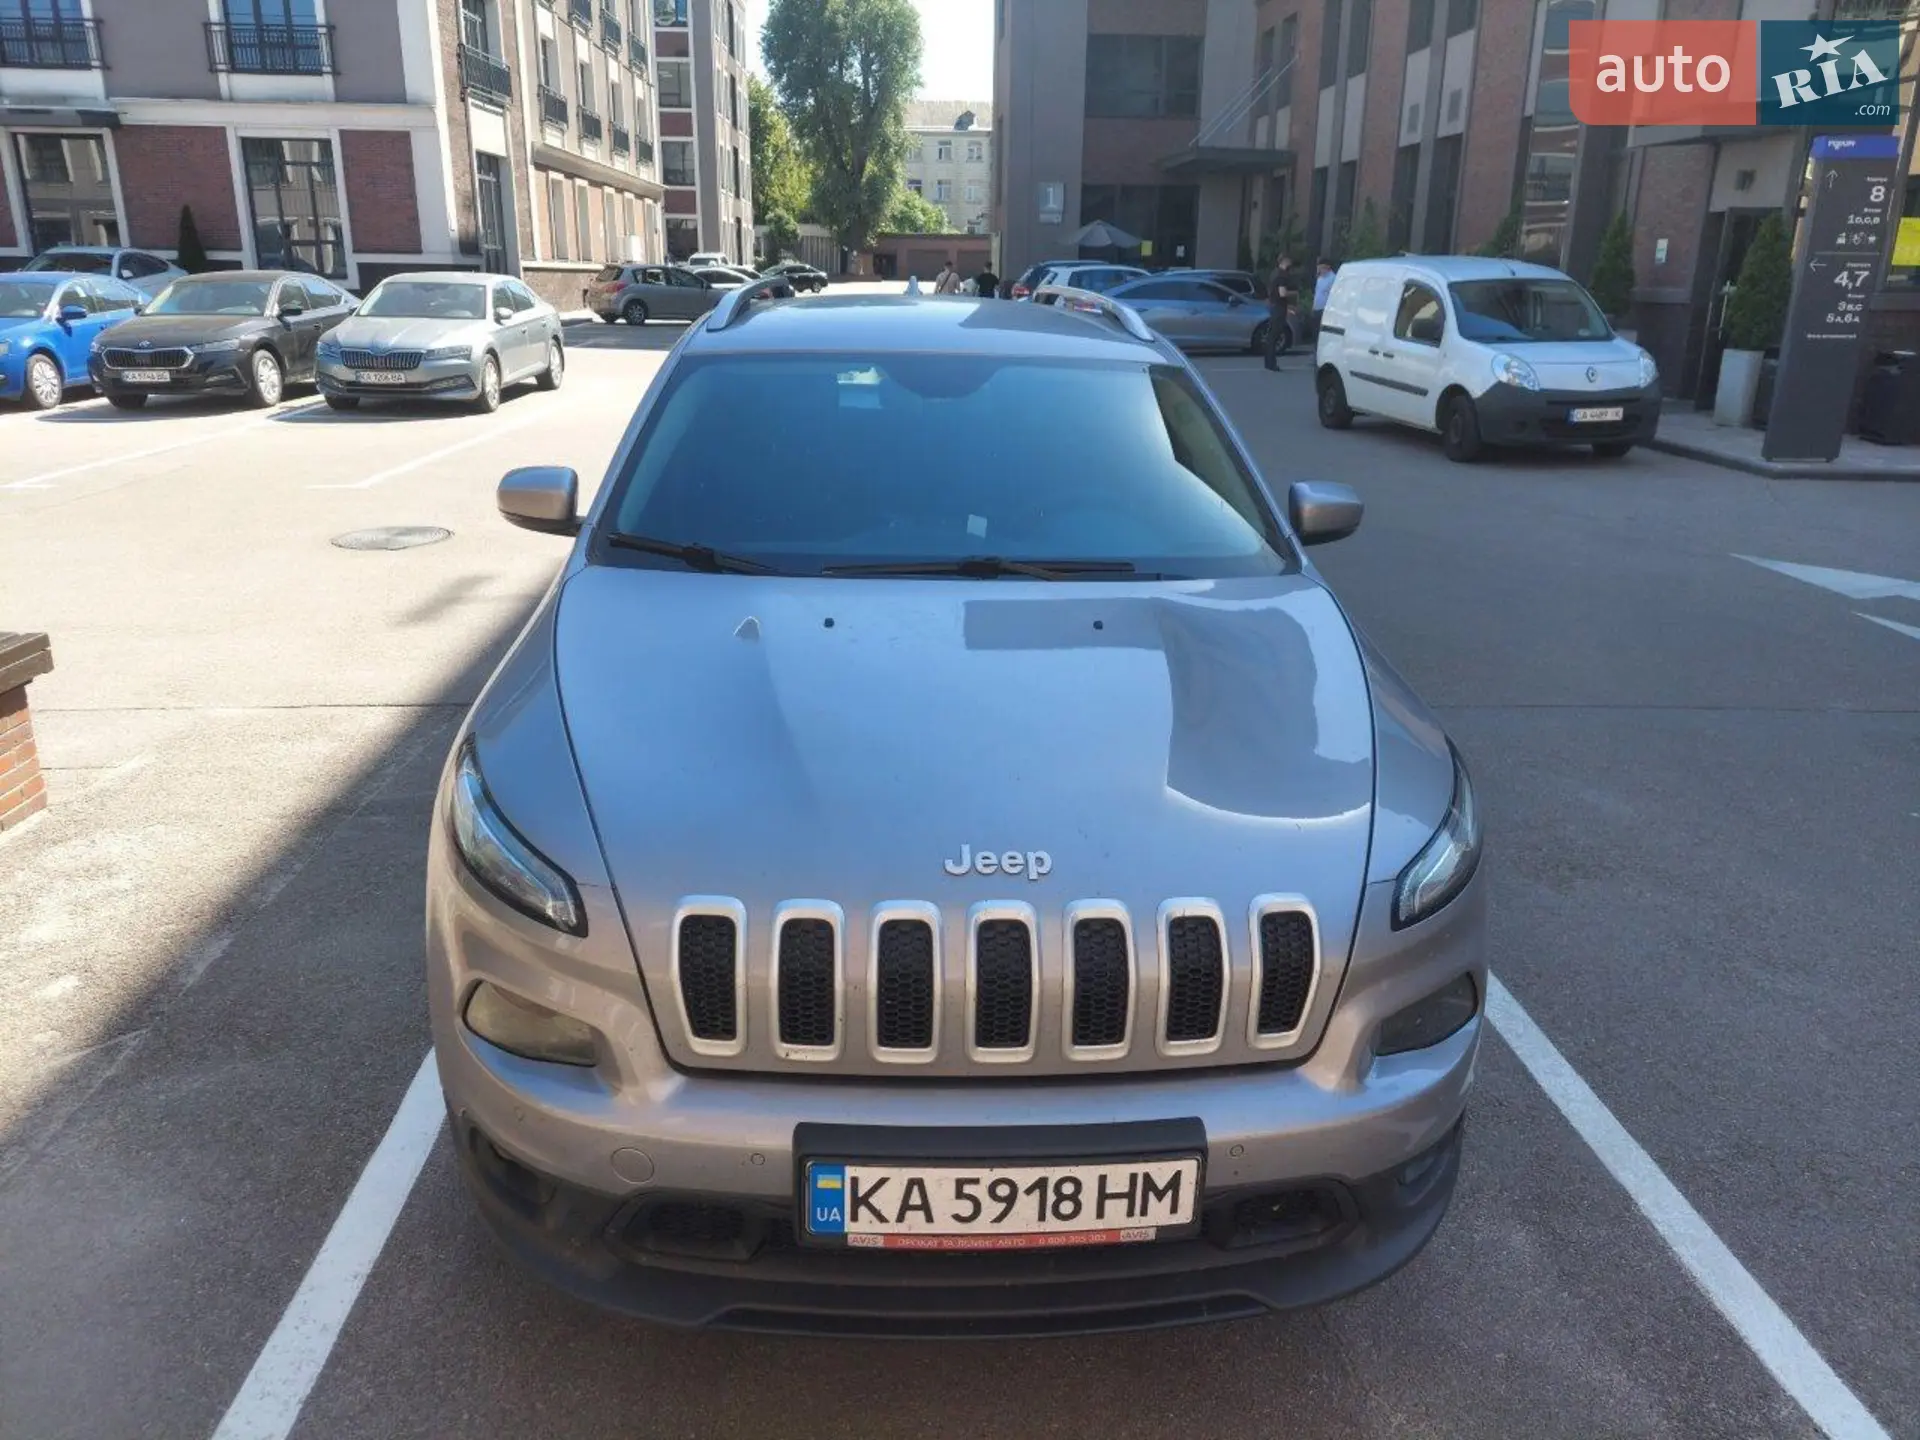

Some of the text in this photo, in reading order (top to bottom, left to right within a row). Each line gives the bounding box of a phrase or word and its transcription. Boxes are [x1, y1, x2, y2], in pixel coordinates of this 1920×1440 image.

[1870, 185, 1886, 202] 8
[1833, 271, 1870, 290] 4,7
[944, 843, 1052, 880] Jeep
[849, 1169, 1183, 1224] KA 5918 HM
[816, 1207, 841, 1222] UA
[851, 1234, 877, 1245] AVIS
